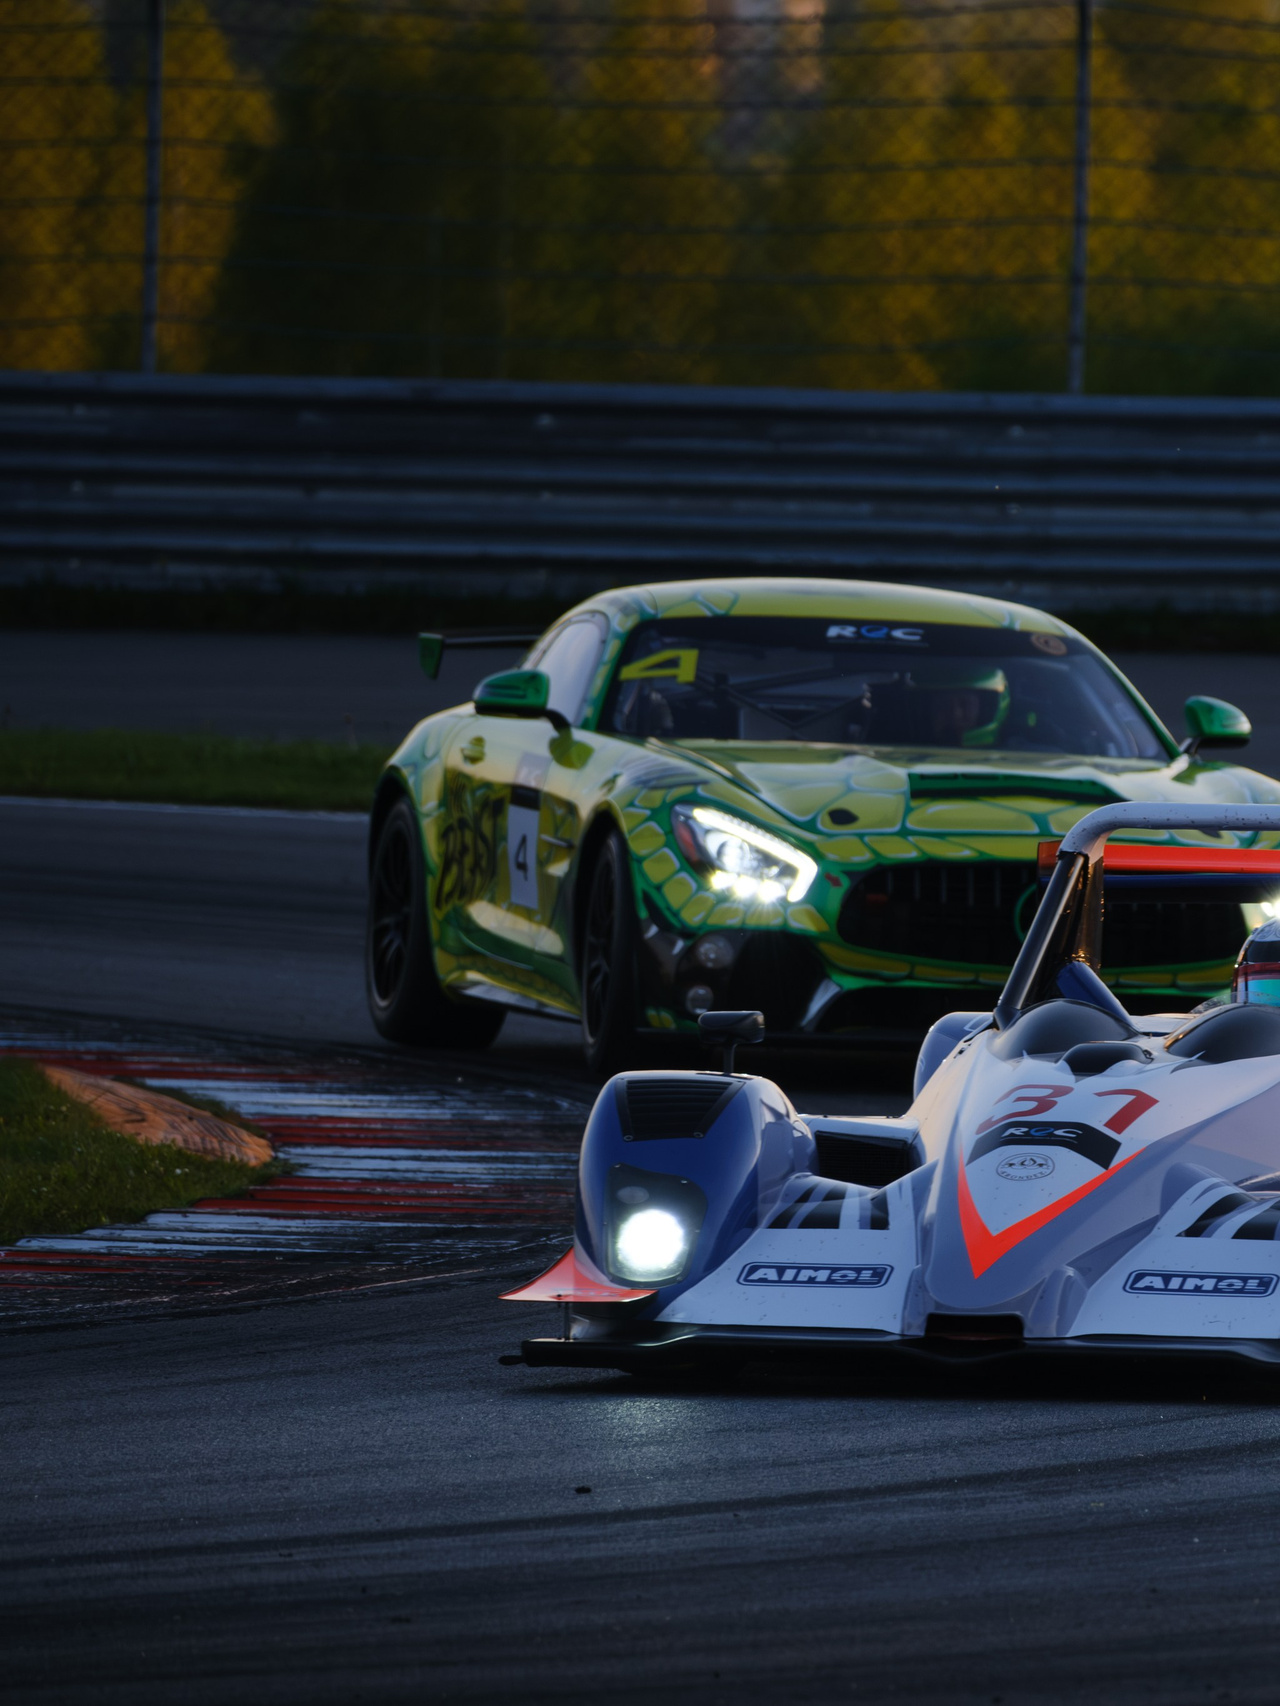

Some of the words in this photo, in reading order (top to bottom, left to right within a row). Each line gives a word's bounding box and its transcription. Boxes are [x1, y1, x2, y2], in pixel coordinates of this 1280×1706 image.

[618, 648, 699, 684] 4
[515, 833, 528, 882] 4
[975, 1084, 1160, 1135] 31
[746, 1267, 881, 1283] AIMOL
[1132, 1275, 1267, 1292] AIMOL
